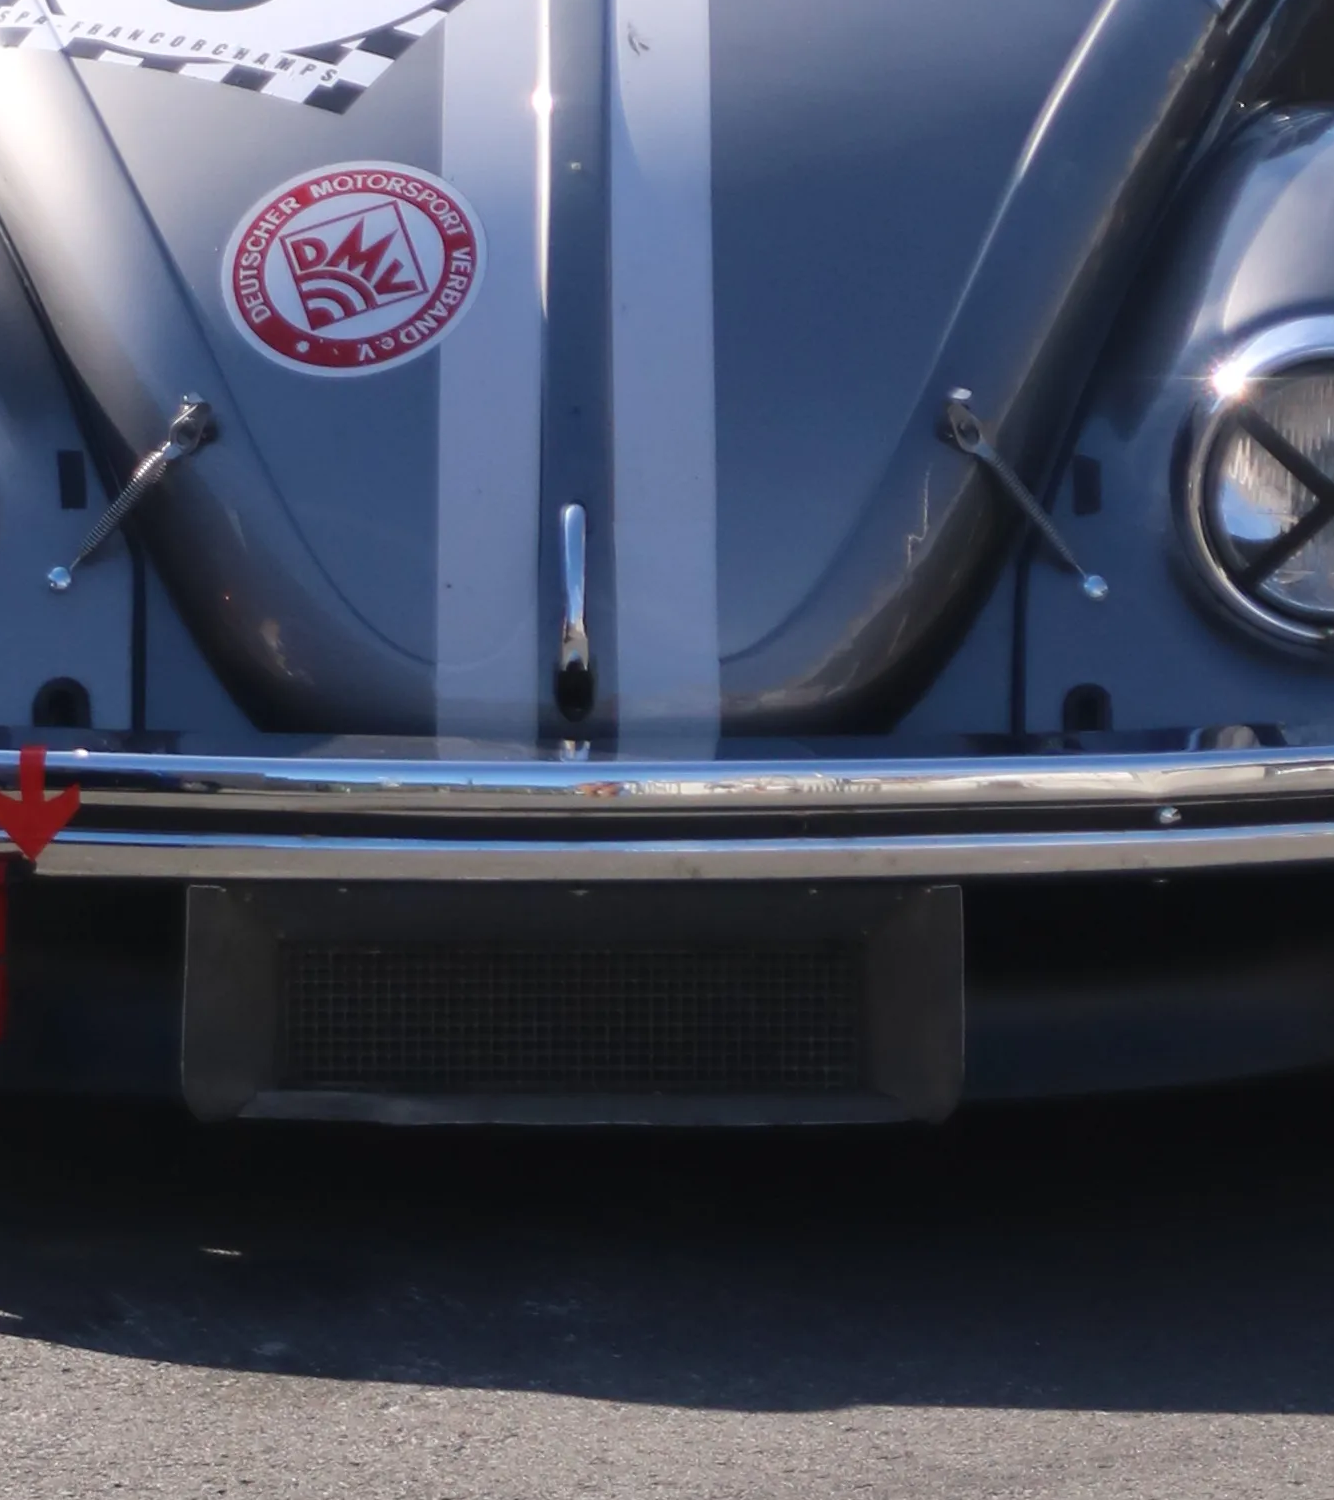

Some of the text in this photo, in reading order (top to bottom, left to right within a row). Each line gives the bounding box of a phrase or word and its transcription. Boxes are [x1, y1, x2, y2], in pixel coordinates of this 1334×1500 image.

[239, 196, 302, 324] DEUTSCHER
[309, 173, 468, 237] MOTORSPORT
[399, 245, 472, 345] VERBAND
[290, 216, 419, 296] DMV
